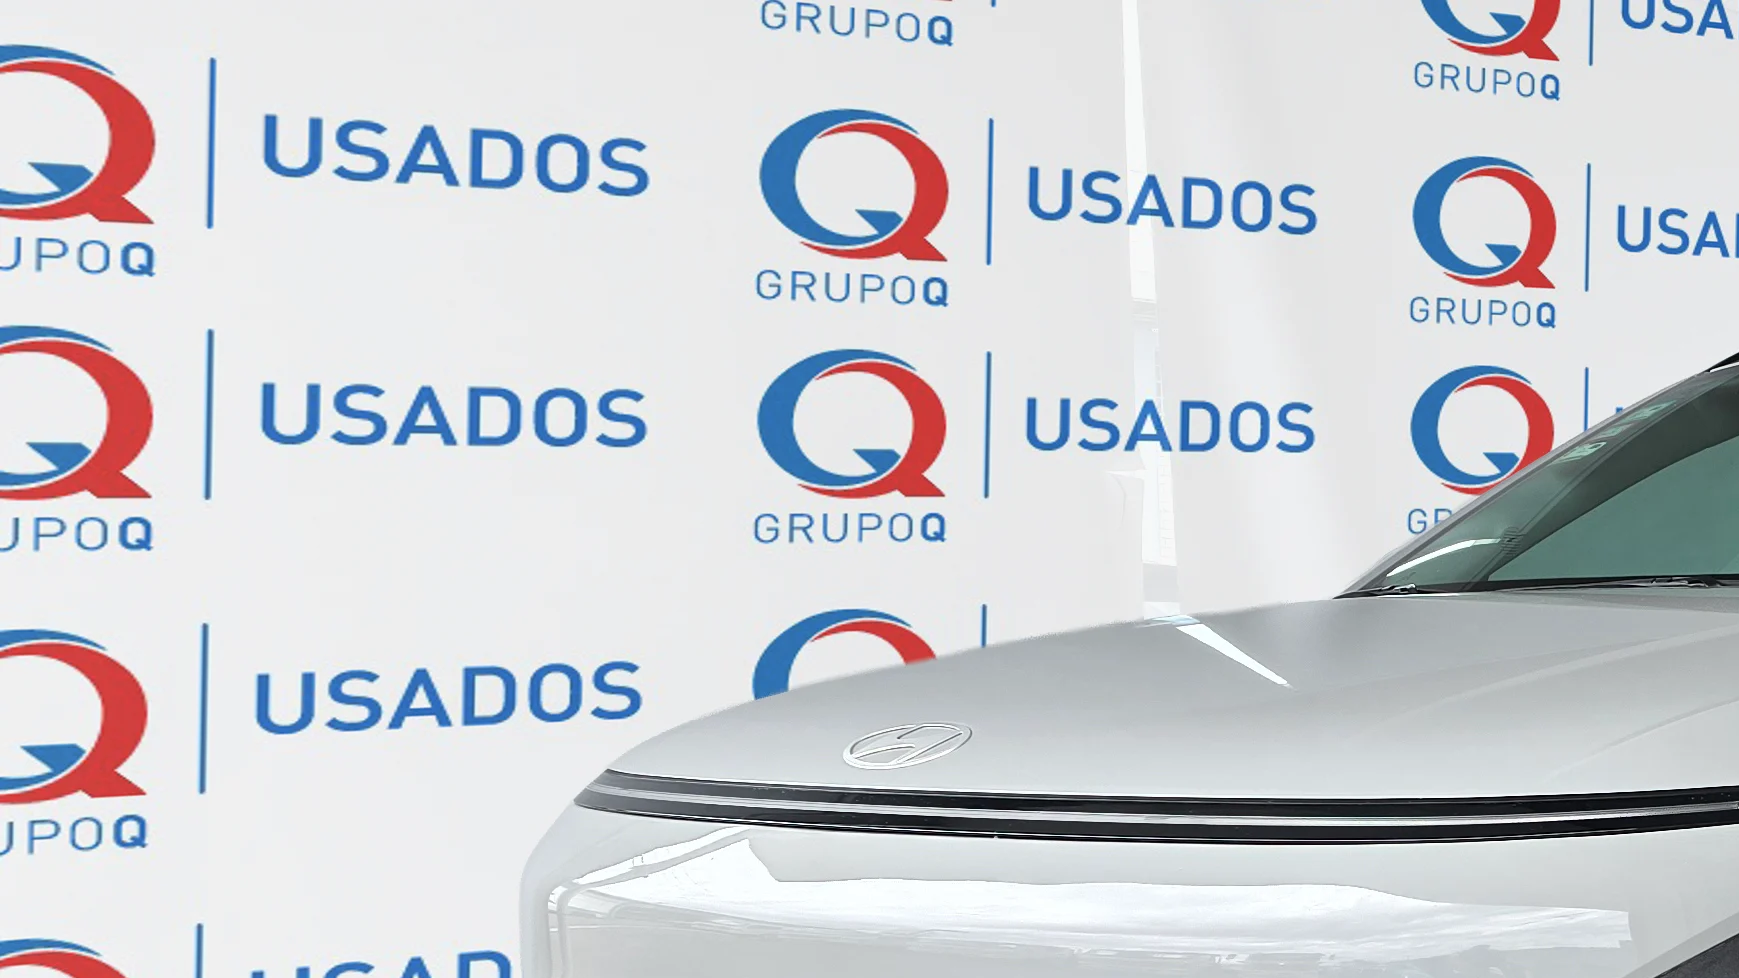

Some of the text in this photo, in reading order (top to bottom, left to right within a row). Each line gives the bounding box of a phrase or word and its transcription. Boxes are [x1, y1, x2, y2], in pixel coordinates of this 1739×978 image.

[759, 0, 955, 47] GRUPOQ
[1413, 60, 1561, 103] GRUPOQ
[263, 112, 651, 198] USADOS
[1027, 164, 1319, 237] USADOS
[0, 235, 157, 278] UPOQ
[754, 268, 950, 308] GRUPOQ
[1409, 295, 1557, 329] GRUPOQ
[259, 380, 649, 449] USADOS
[1024, 396, 1317, 455] USADOS
[0, 515, 155, 554] UPOQ
[753, 511, 947, 545] GRUPOQ
[253, 659, 643, 736] USADOS
